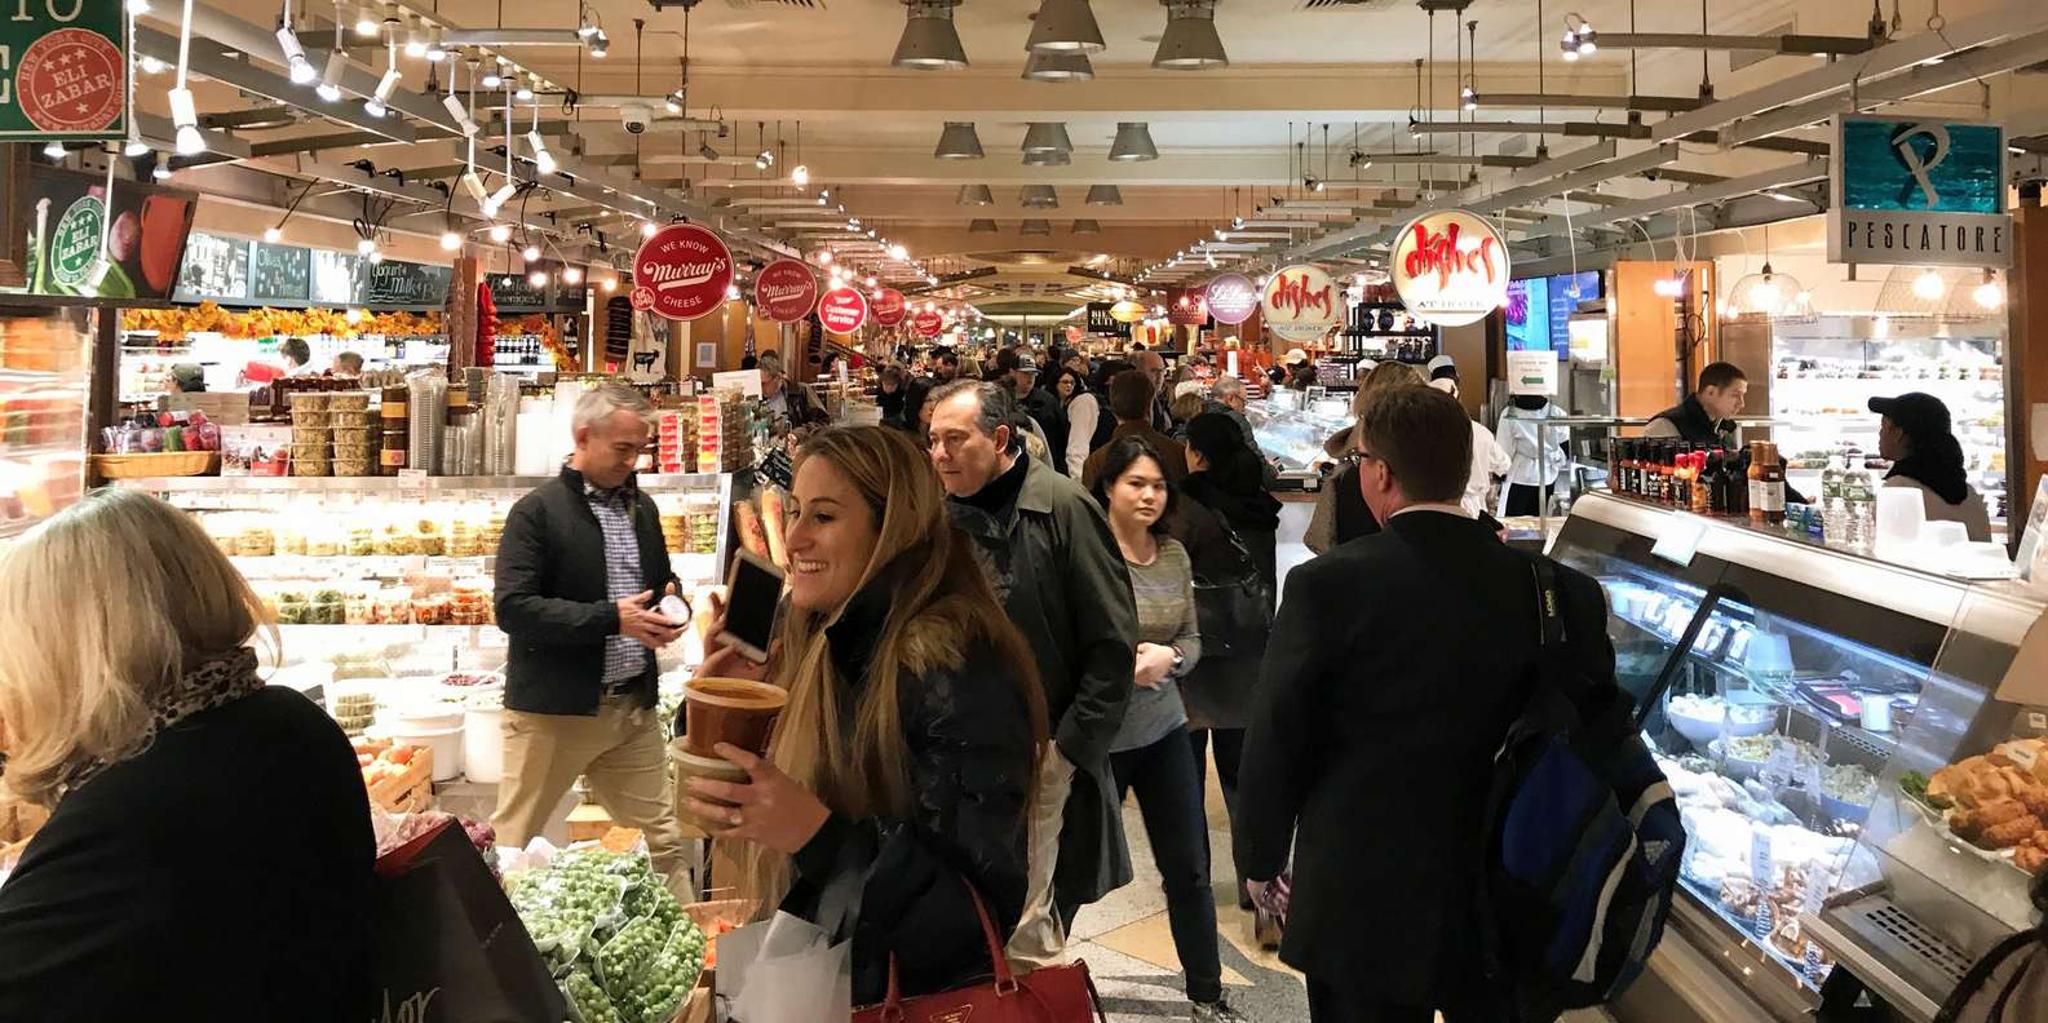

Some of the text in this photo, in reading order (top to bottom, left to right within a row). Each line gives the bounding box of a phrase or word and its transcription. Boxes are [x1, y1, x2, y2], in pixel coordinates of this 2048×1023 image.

[51, 64, 88, 88] ELI
[40, 73, 112, 110] ZABAR
[1891, 122, 1951, 209] P
[62, 235, 98, 261] ZABAR
[72, 226, 90, 243] ELI
[660, 239, 709, 254] WE KNOW
[1848, 220, 2003, 253] PESCATORE
[1405, 221, 1494, 290] dishes
[643, 257, 726, 292] Murray's
[663, 295, 703, 308] CHEESE
[761, 281, 813, 304] Murray's
[1272, 272, 1332, 319] dishes
